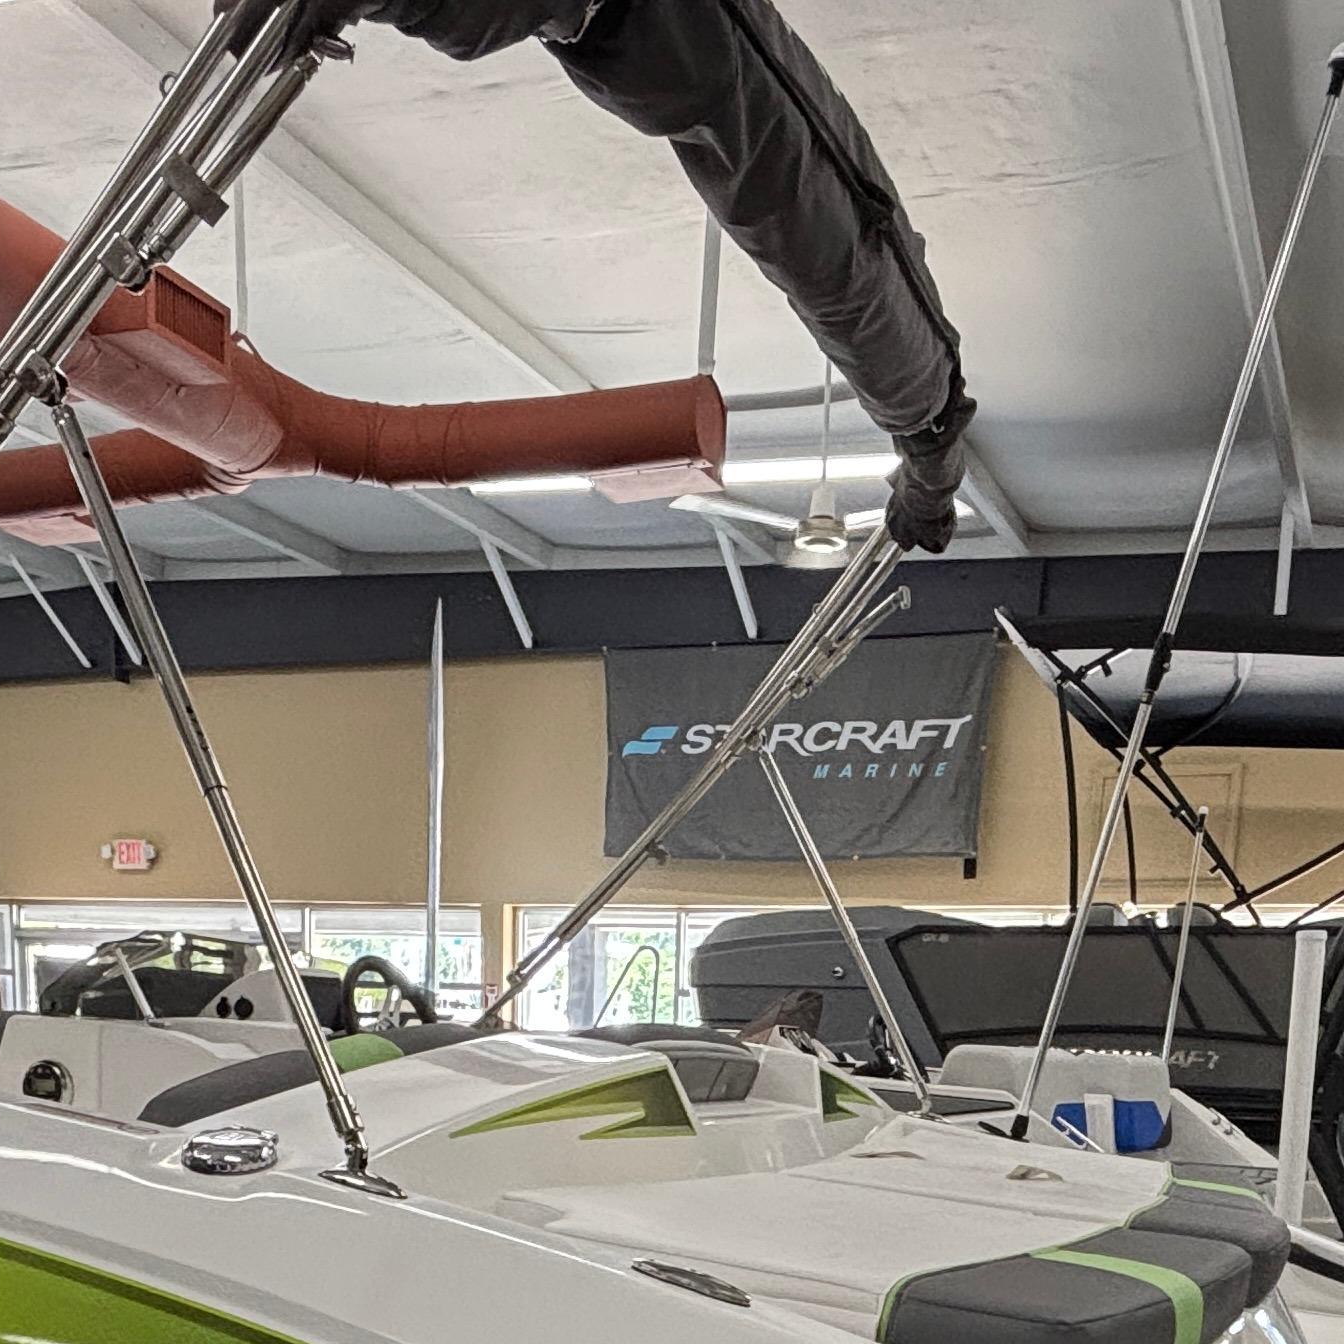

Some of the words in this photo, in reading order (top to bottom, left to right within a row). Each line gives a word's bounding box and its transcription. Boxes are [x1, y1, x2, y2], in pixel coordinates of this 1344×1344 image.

[681, 714, 973, 757] SRCRAFT
[813, 761, 951, 780] MARINE
[117, 841, 143, 865] EXIT
